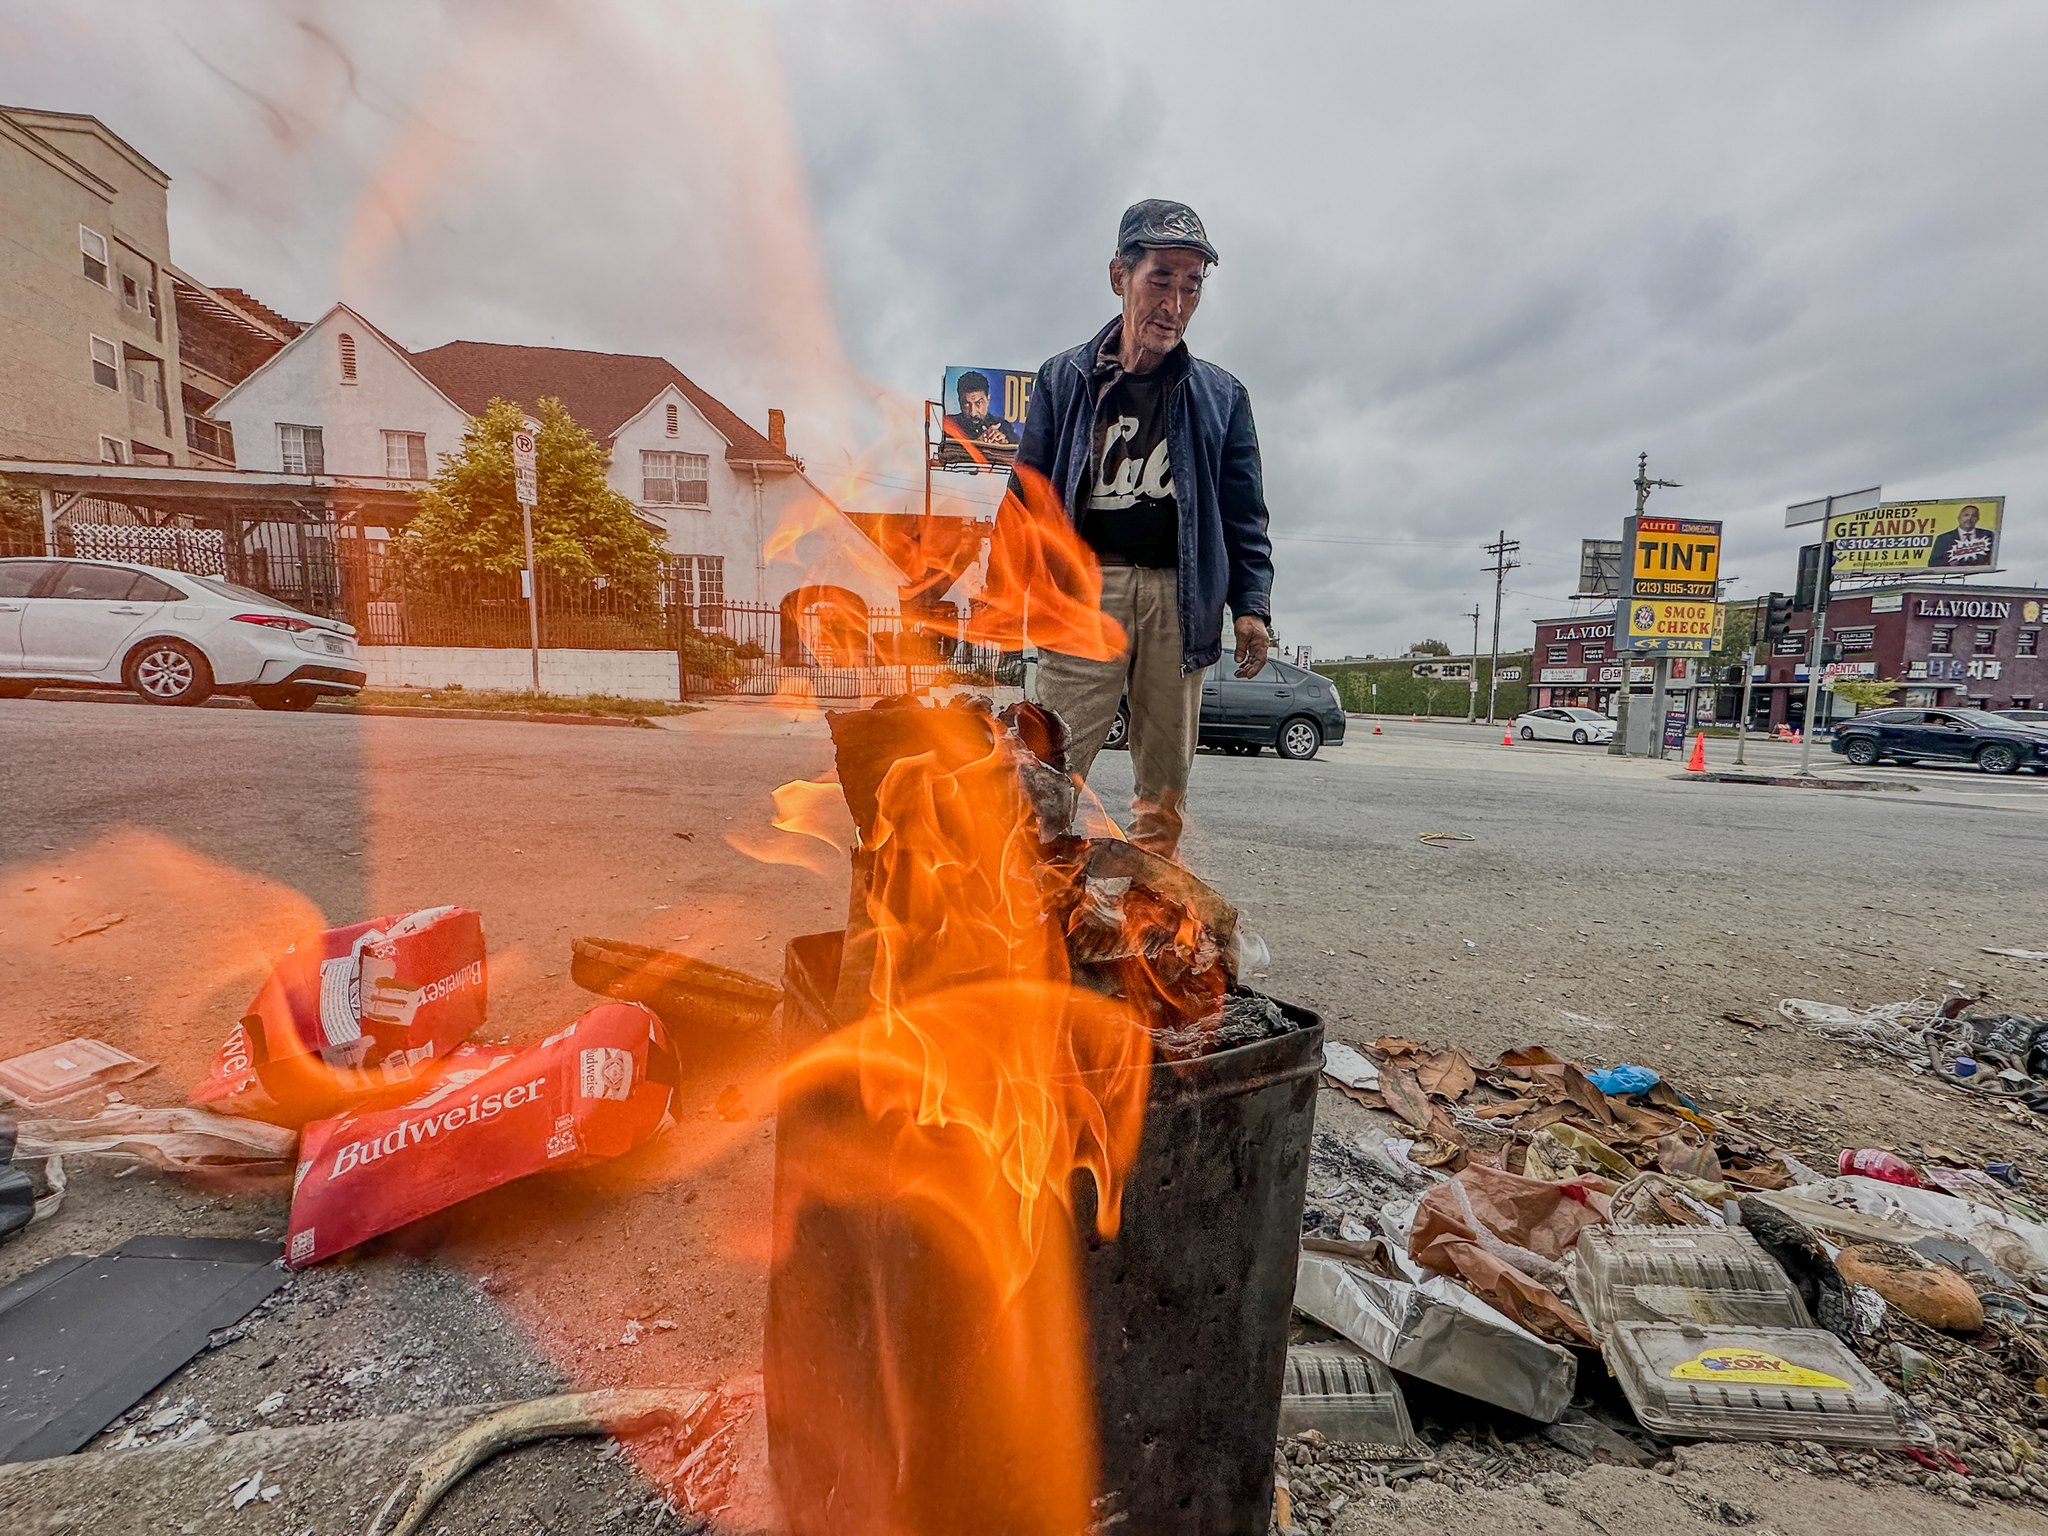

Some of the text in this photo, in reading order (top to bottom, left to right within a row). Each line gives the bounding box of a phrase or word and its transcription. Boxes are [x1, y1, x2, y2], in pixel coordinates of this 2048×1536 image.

[1004, 375, 1036, 423] DE
[1855, 508, 1918, 521] INJURED?
[1640, 522, 1675, 531] AUTO
[1834, 518, 1936, 537] GET ANDY!
[1848, 536, 1929, 549] 310-213-2100
[1638, 541, 1716, 571] TINT
[1849, 549, 1924, 561] ELLIS LAW
[1636, 581, 1712, 595] (213) 905-3777
[1664, 606, 1706, 619] SMOG
[1657, 620, 1711, 634] CHECK
[1712, 608, 1723, 646] KIMS
[1667, 640, 1703, 650] STAR
[1502, 671, 1520, 680] 3330
[1829, 663, 1861, 674] DENTAL
[417, 961, 482, 1007] Budweiser
[328, 1077, 546, 1181] Budweiser
[1719, 1356, 1781, 1372] FOXY
